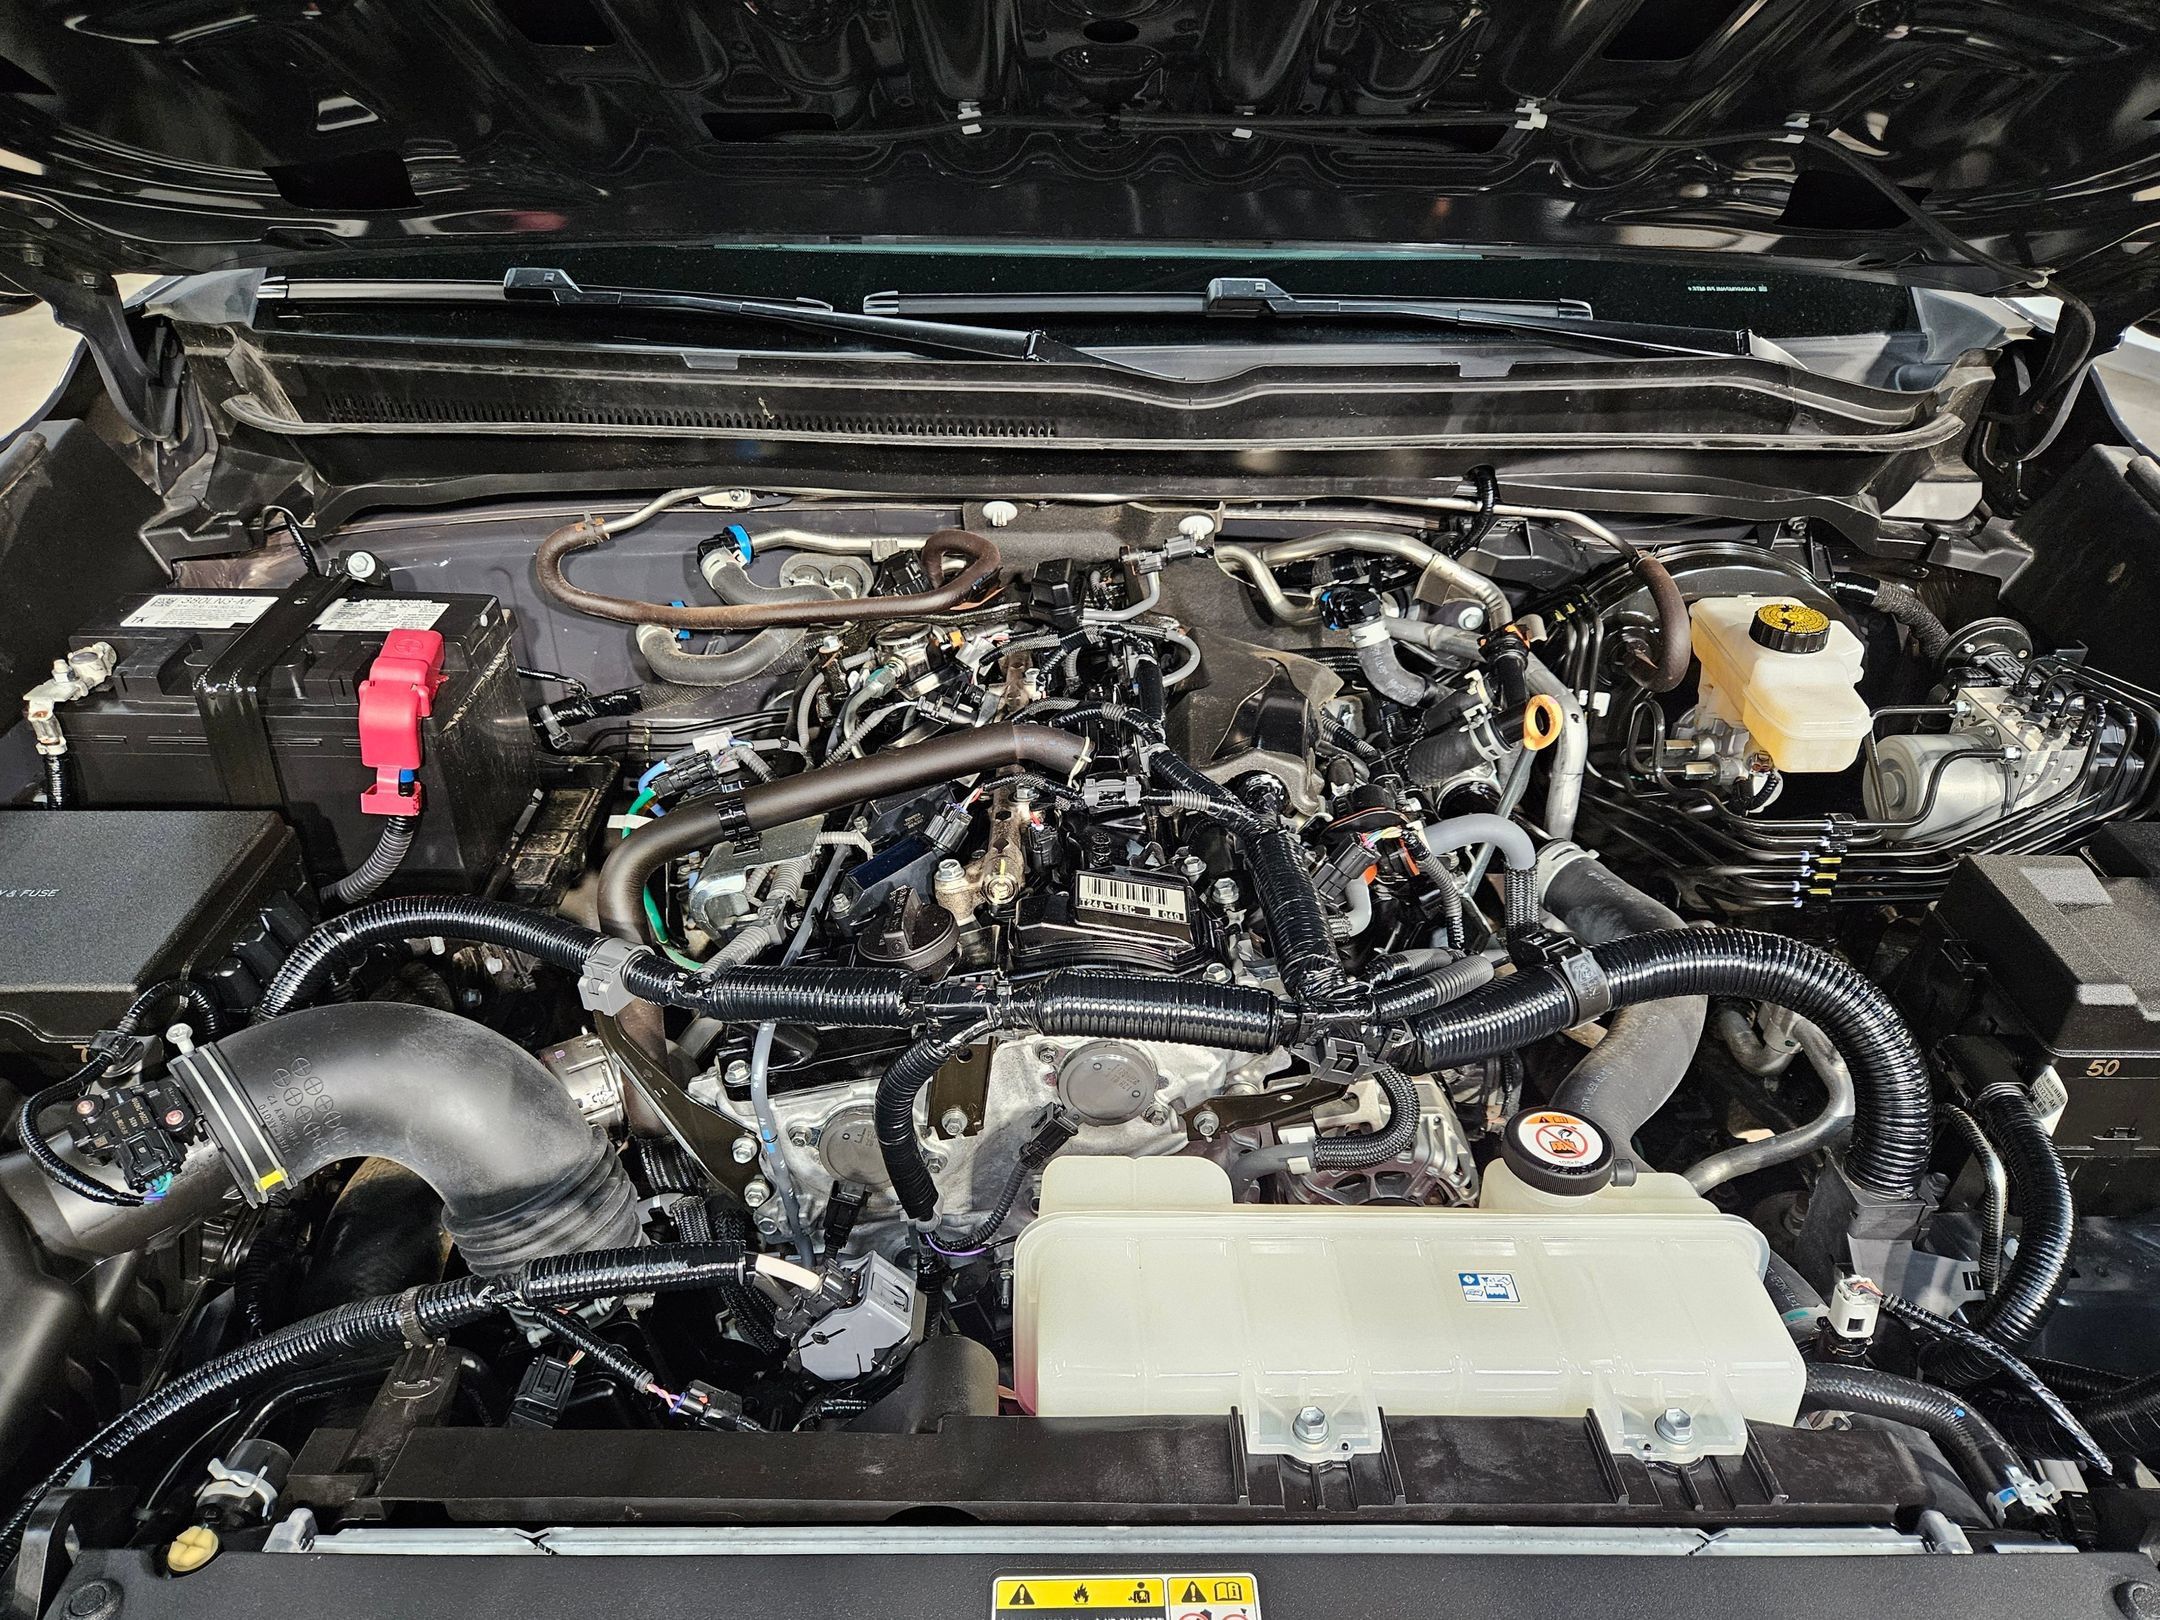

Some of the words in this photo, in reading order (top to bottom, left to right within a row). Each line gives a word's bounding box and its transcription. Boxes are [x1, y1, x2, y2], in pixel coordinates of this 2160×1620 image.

[6, 889, 17, 898] &
[19, 889, 61, 897] FUSE
[2086, 1059, 2121, 1077] 50
